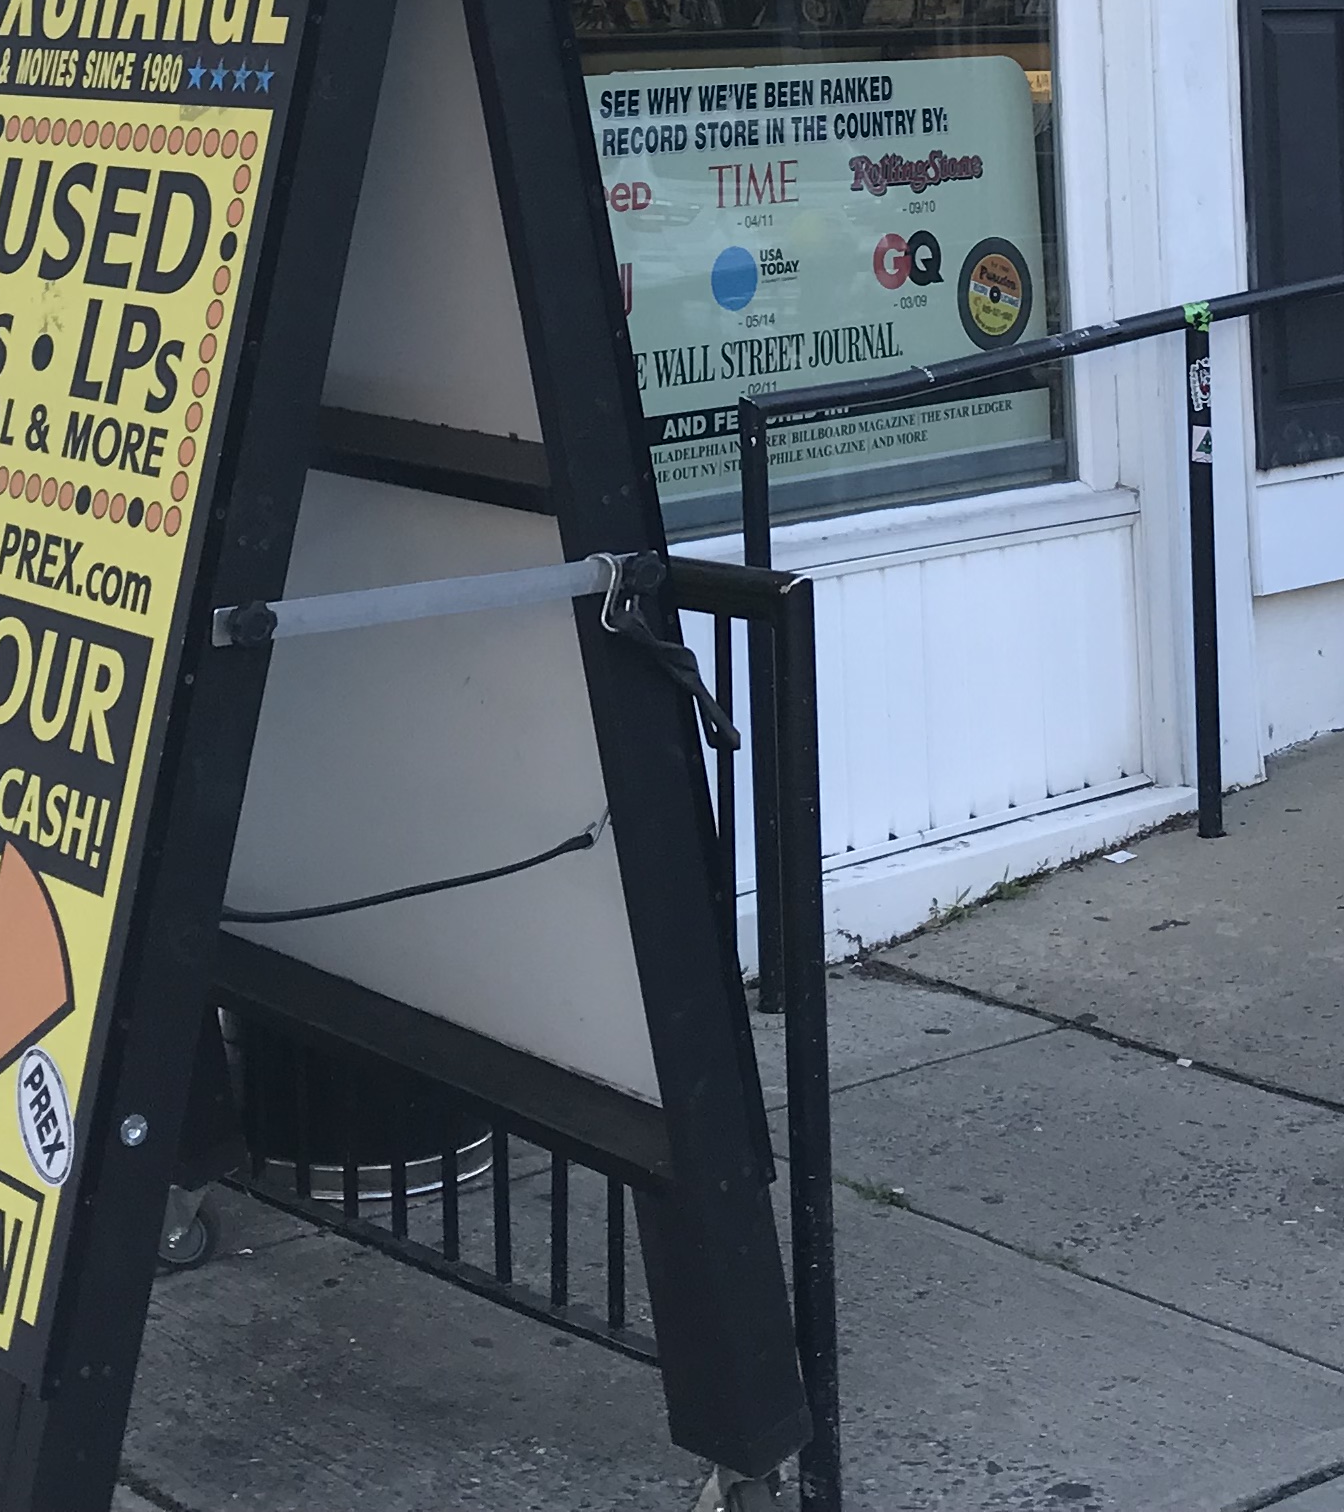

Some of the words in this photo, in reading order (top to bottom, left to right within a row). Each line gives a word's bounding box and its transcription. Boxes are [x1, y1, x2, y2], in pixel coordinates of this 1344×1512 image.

[14, 50, 78, 88] MOVIES
[82, 53, 133, 91] SINCE
[139, 55, 183, 93] 1980
[600, 90, 640, 119] SEE
[647, 86, 691, 116] WHY
[698, 82, 758, 113] WE'VE
[765, 79, 814, 108] BEEN
[820, 75, 894, 106] RANKED
[601, 123, 687, 157] RECORD
[694, 119, 760, 150] STORE
[766, 117, 786, 145] IN
[791, 114, 829, 143] THE
[833, 108, 918, 141] COUNTRY
[921, 106, 950, 134] BY:
[708, 160, 799, 209] TIME
[759, 248, 784, 262] USA
[760, 260, 800, 276] TODAY
[873, 230, 944, 289] GQ
[69, 297, 185, 414] LPs
[653, 348, 716, 389] WALL
[721, 336, 806, 381] STREET
[24, 403, 50, 453] &
[61, 411, 169, 479] MORE
[651, 444, 727, 465] ILADELPHIA
[791, 423, 856, 444] BILLBOARD
[858, 412, 916, 434] MAGAZINE
[921, 409, 942, 425] THE
[943, 405, 970, 421] STAR
[971, 399, 1013, 417] LEDGER
[663, 415, 707, 440] AND
[672, 465, 698, 482] OUT
[701, 462, 718, 477] NY
[806, 439, 866, 460] MAGAZINE
[872, 433, 895, 450] AND
[896, 429, 928, 446] MORE
[23, 1061, 67, 1169] PREX
